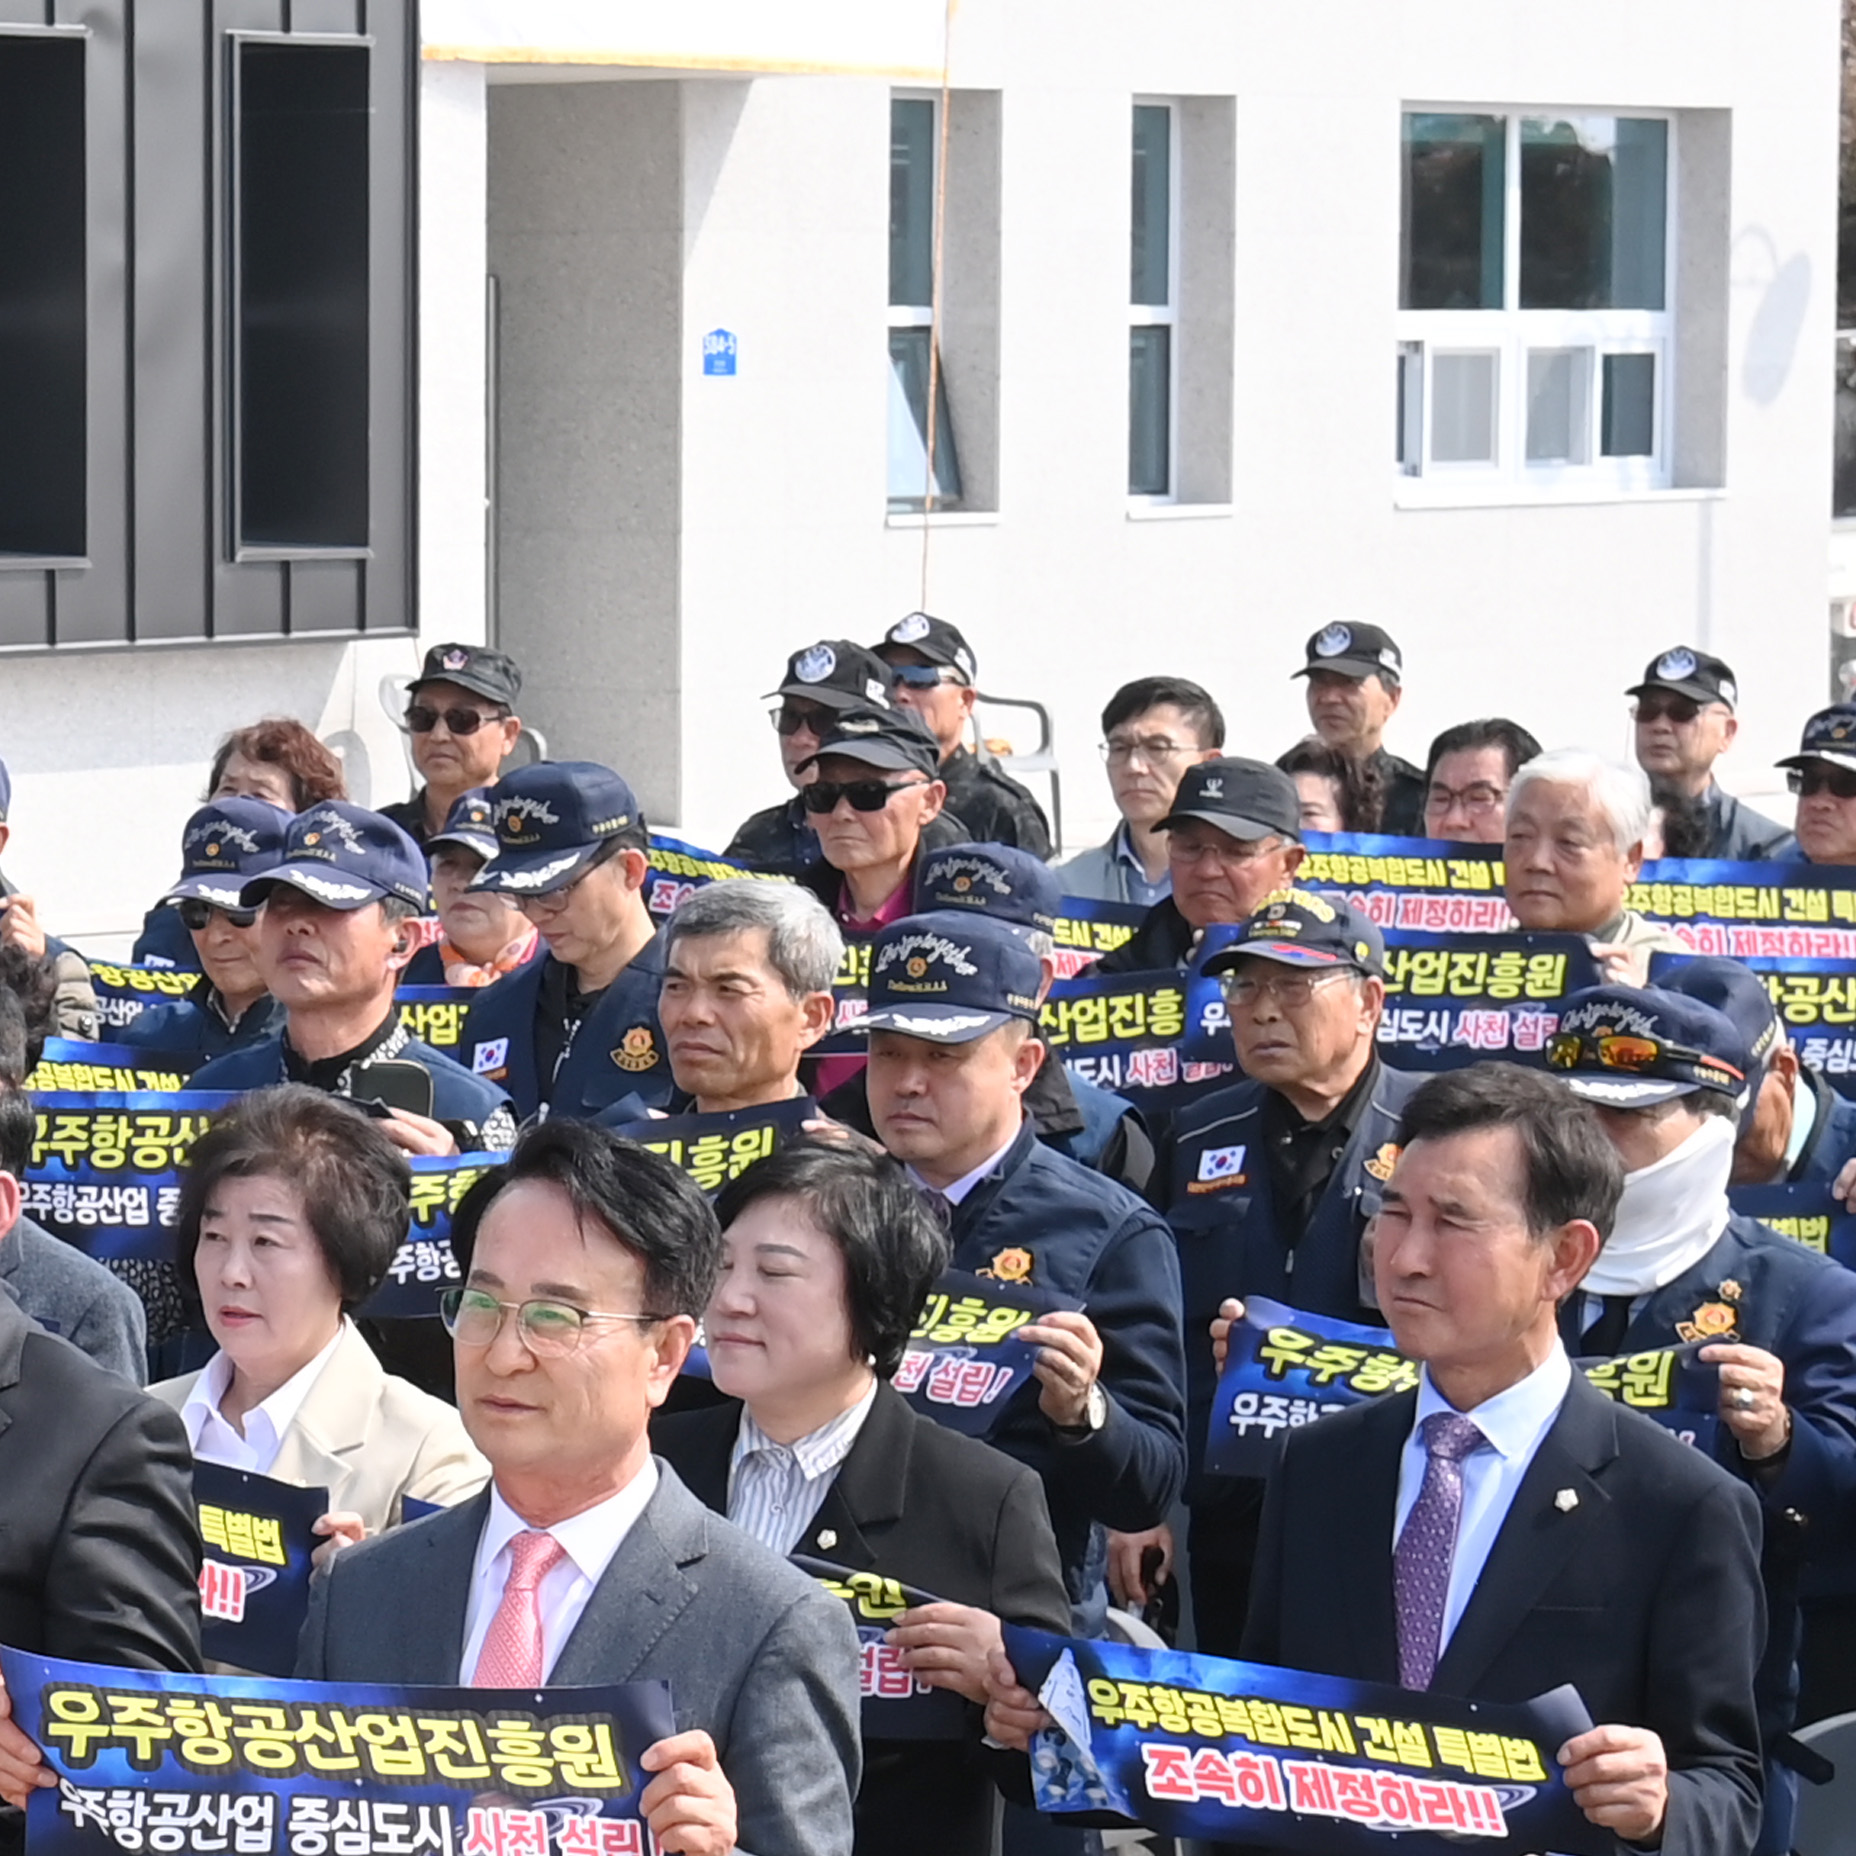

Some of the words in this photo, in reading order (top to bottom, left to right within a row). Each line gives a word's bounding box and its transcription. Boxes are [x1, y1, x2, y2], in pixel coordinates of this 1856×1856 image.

[1382, 951, 1567, 998] 산업진흥원
[1038, 988, 1184, 1045] 산업진흥
[1377, 1008, 1450, 1044] 심도시
[1453, 1009, 1509, 1049] 사천
[1127, 1047, 1178, 1088] 사천
[929, 1356, 1012, 1409] 설립!
[199, 1503, 286, 1567] 특별법
[47, 1690, 622, 1792] 우주항공산업진흥원
[1086, 1677, 1355, 1757] 우주항공복합도시
[1357, 1714, 1432, 1765] 건설
[1433, 1727, 1549, 1783] 특별법
[60, 1777, 275, 1854] 우주항공산업
[1141, 1742, 1282, 1809] 조속히
[1282, 1758, 1510, 1838] 제정하라!!
